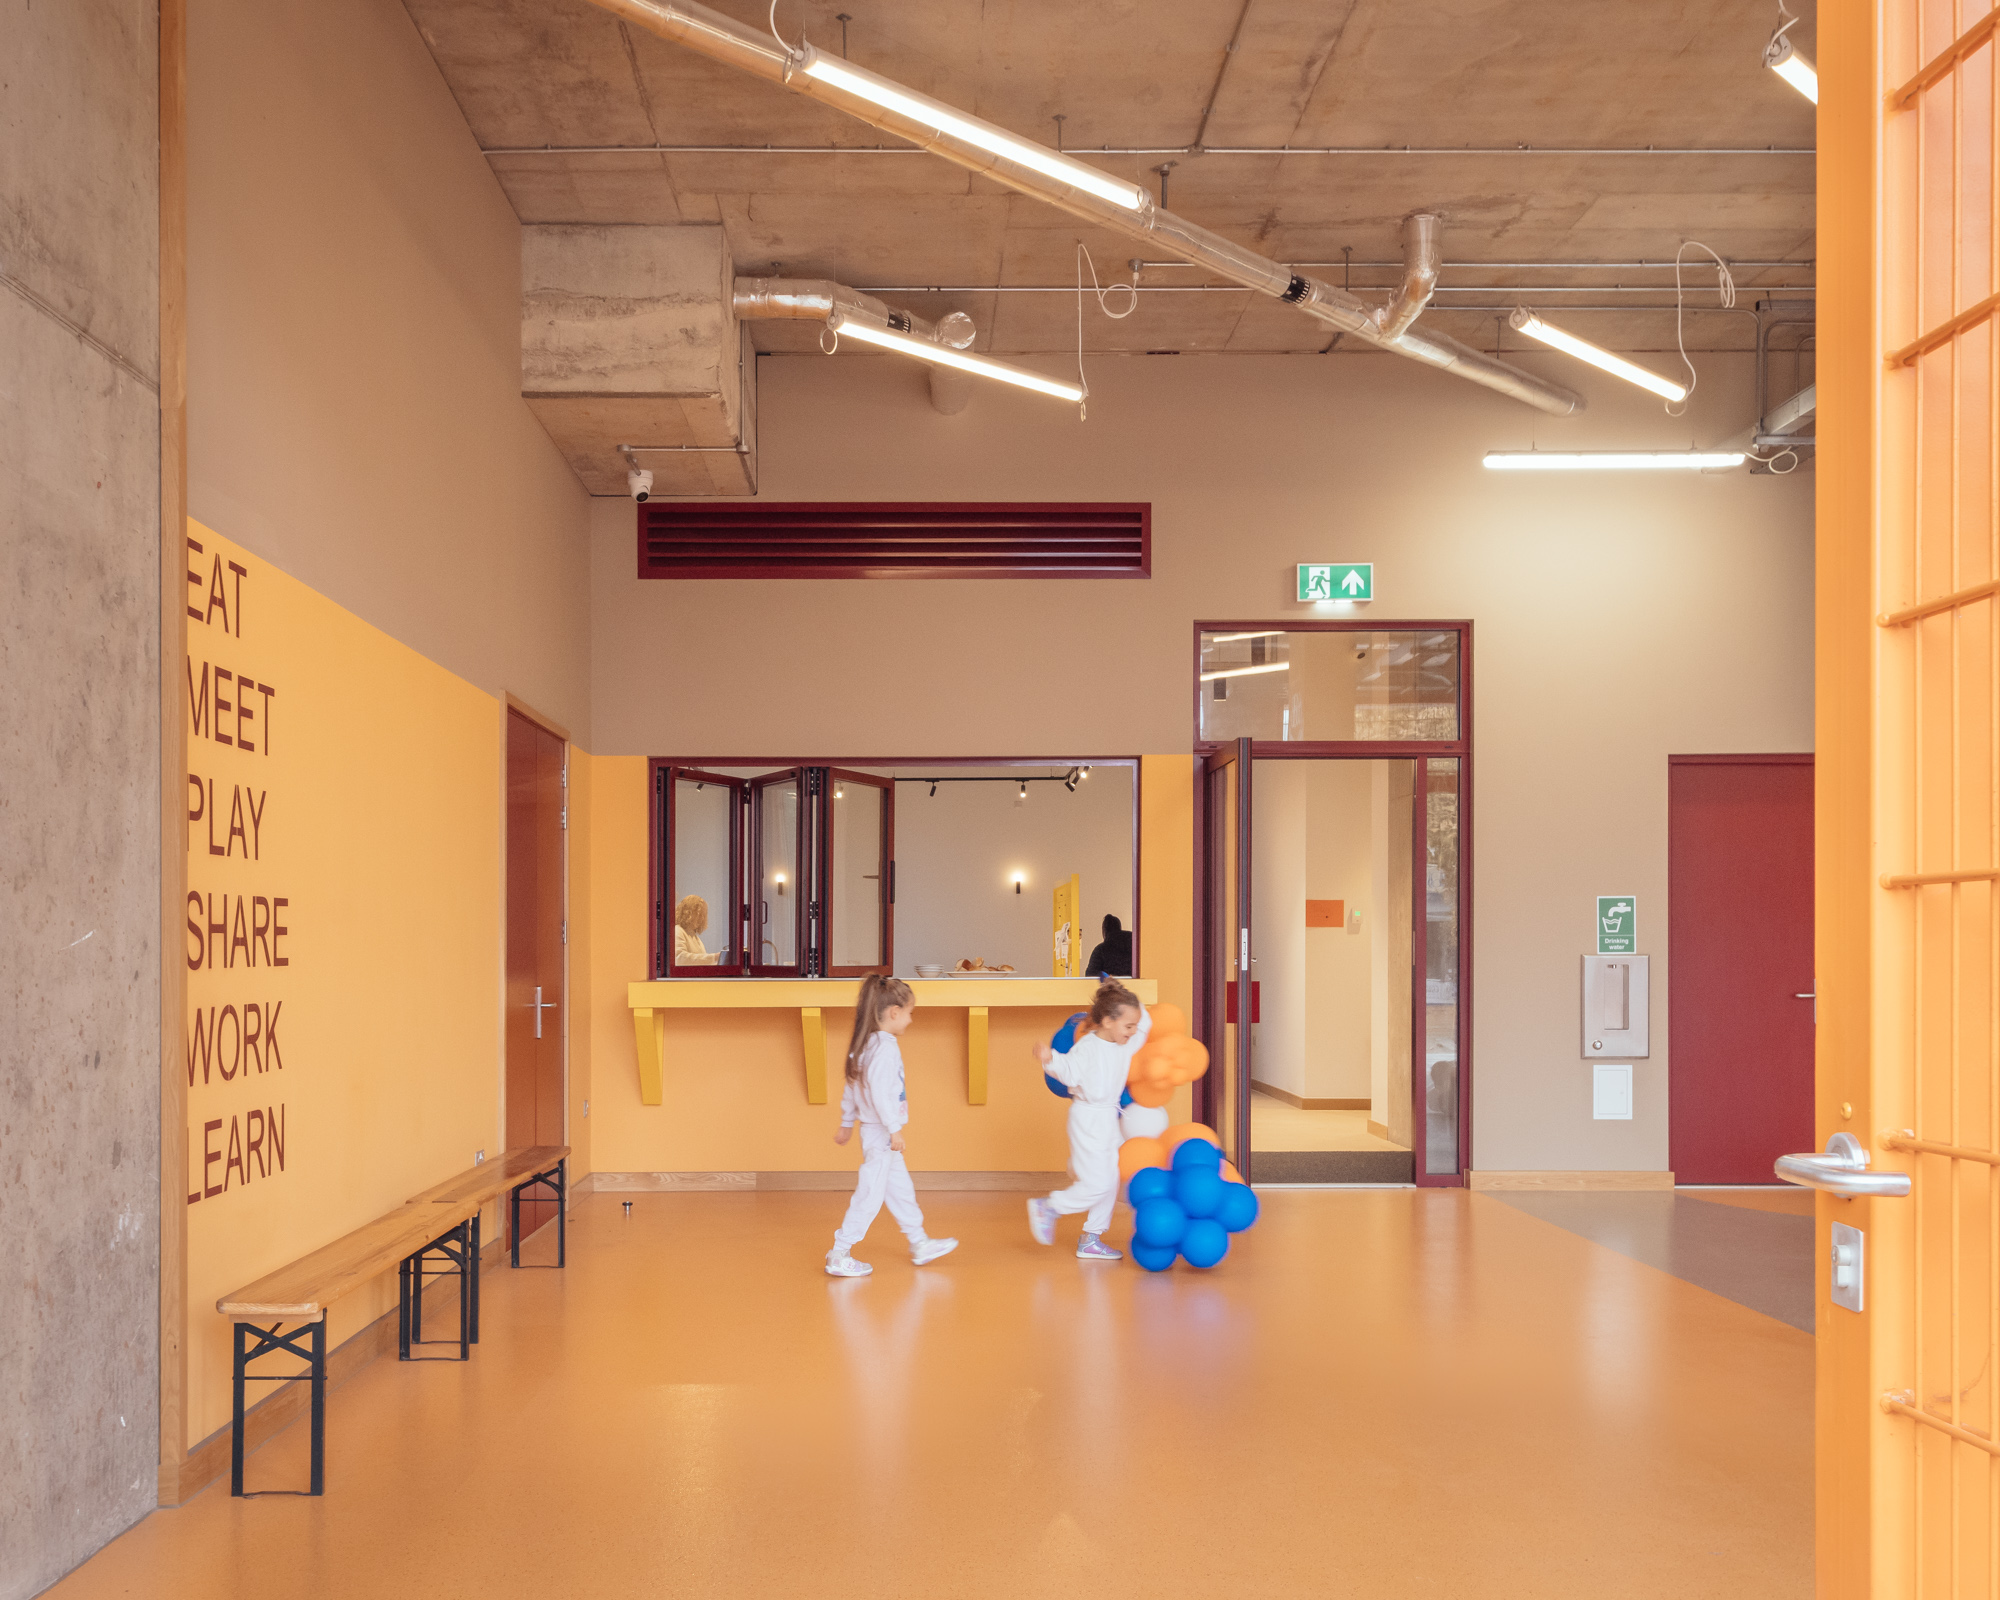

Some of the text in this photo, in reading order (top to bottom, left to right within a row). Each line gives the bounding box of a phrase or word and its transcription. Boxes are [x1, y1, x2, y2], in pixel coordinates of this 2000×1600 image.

[187, 537, 247, 638] EAT
[187, 655, 275, 756] MEET
[187, 774, 266, 860] PLAY
[187, 891, 289, 971] SHARE
[187, 1001, 283, 1088] WORK
[187, 1103, 285, 1205] LEARN
